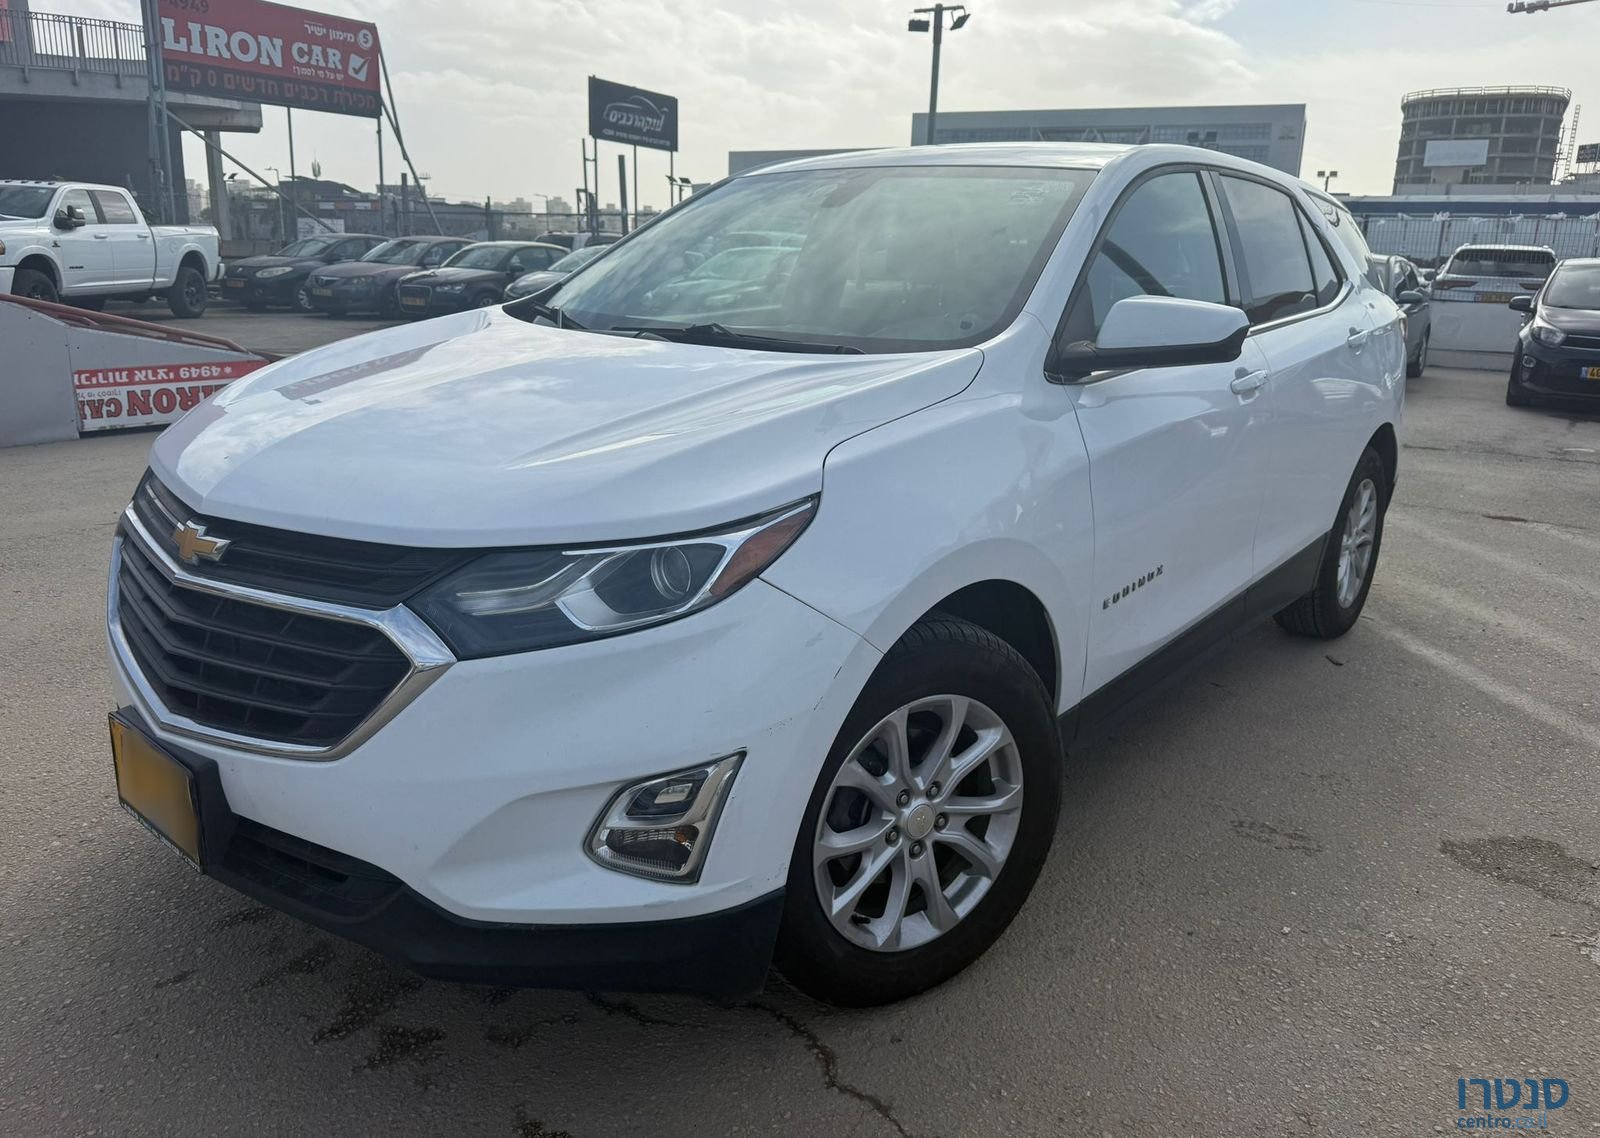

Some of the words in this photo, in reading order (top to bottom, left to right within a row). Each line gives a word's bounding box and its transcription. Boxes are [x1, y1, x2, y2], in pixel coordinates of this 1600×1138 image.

[304, 24, 327, 36] ישיר
[329, 29, 355, 42] מימון
[161, 17, 283, 68] LIRON
[291, 41, 343, 70] CAR
[224, 73, 279, 95] חדשים
[284, 82, 328, 102] רכבים
[134, 368, 174, 381] ארצי
[126, 384, 228, 416] RON
[1102, 564, 1164, 610] EQUINOX
